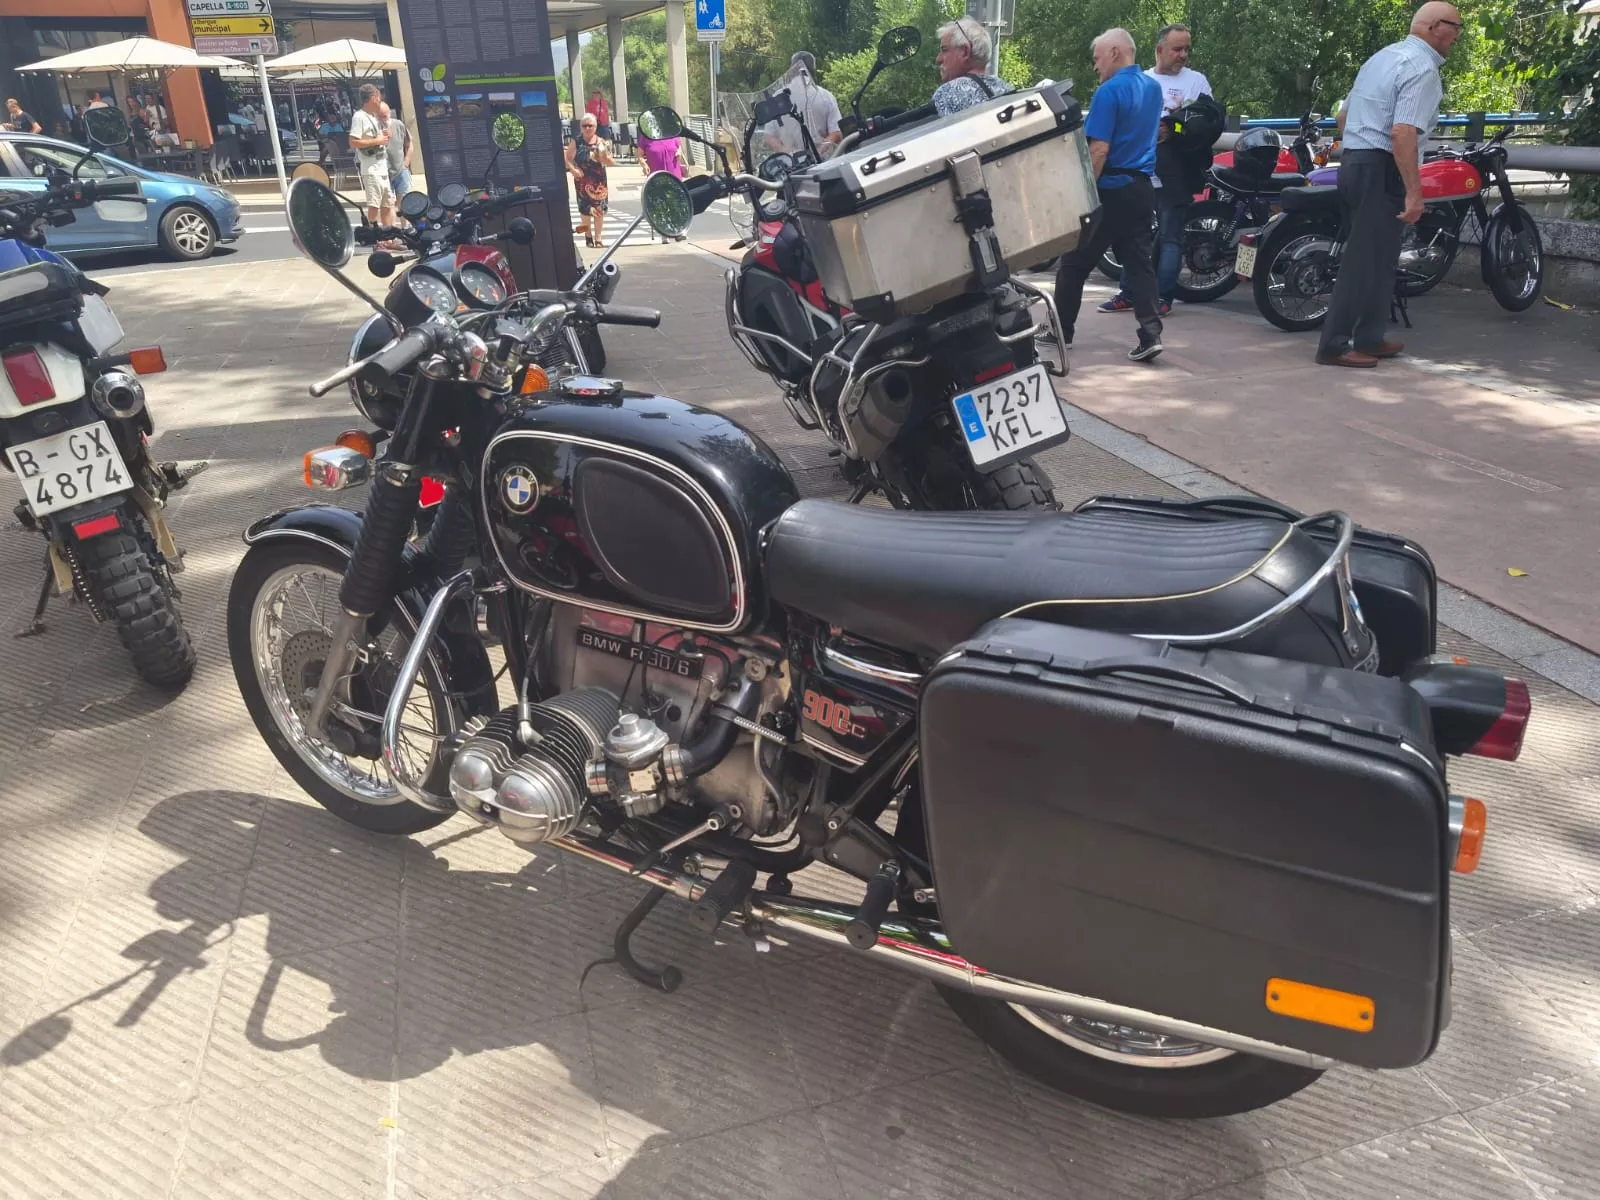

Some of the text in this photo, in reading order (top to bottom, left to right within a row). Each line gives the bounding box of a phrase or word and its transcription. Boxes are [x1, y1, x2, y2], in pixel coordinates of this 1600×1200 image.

[190, 3, 224, 11] CAPELLA
[193, 25, 231, 33] municipal
[977, 373, 1041, 422] 7237
[969, 422, 979, 433] E
[988, 412, 1043, 451] KFL
[36, 458, 122, 506] 4874
[582, 633, 621, 654] BMW
